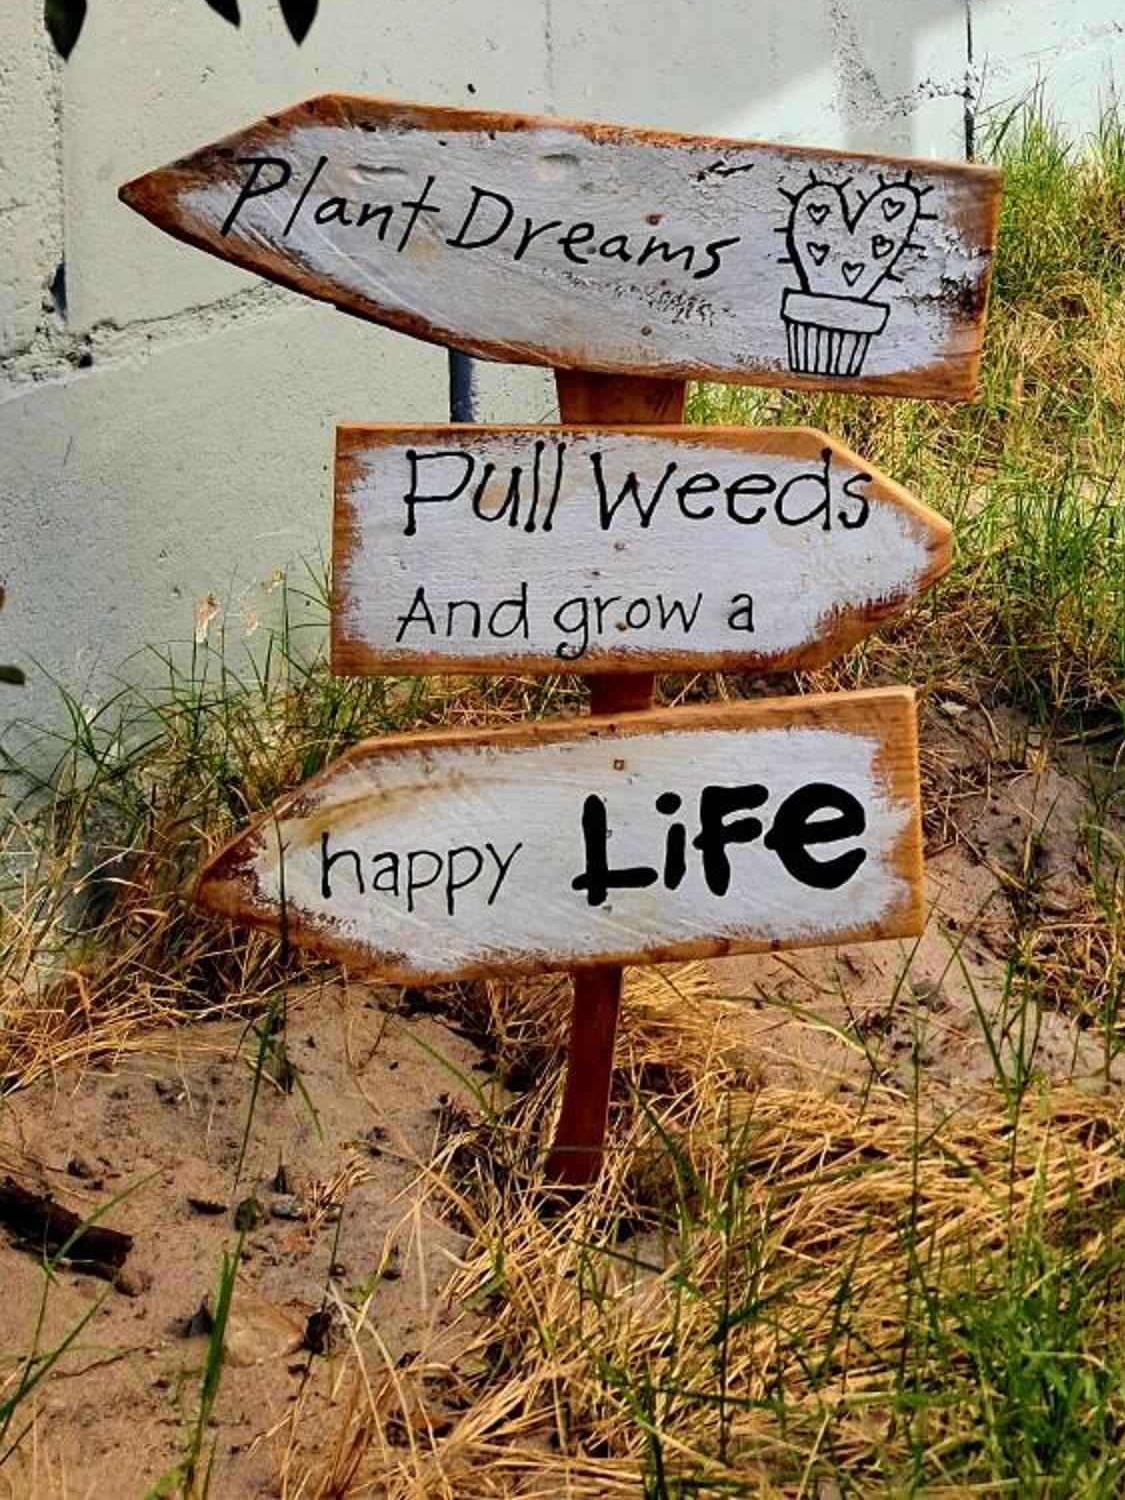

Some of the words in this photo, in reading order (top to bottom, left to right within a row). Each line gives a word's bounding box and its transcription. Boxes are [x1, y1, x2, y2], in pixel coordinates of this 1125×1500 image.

[220, 154, 440, 252] Plant
[447, 186, 741, 279] Dreams
[403, 440, 567, 536] Pull
[589, 446, 873, 531] Weeds
[395, 581, 531, 643] And
[553, 592, 704, 661] grow
[726, 593, 756, 633] a
[320, 831, 523, 916] happy
